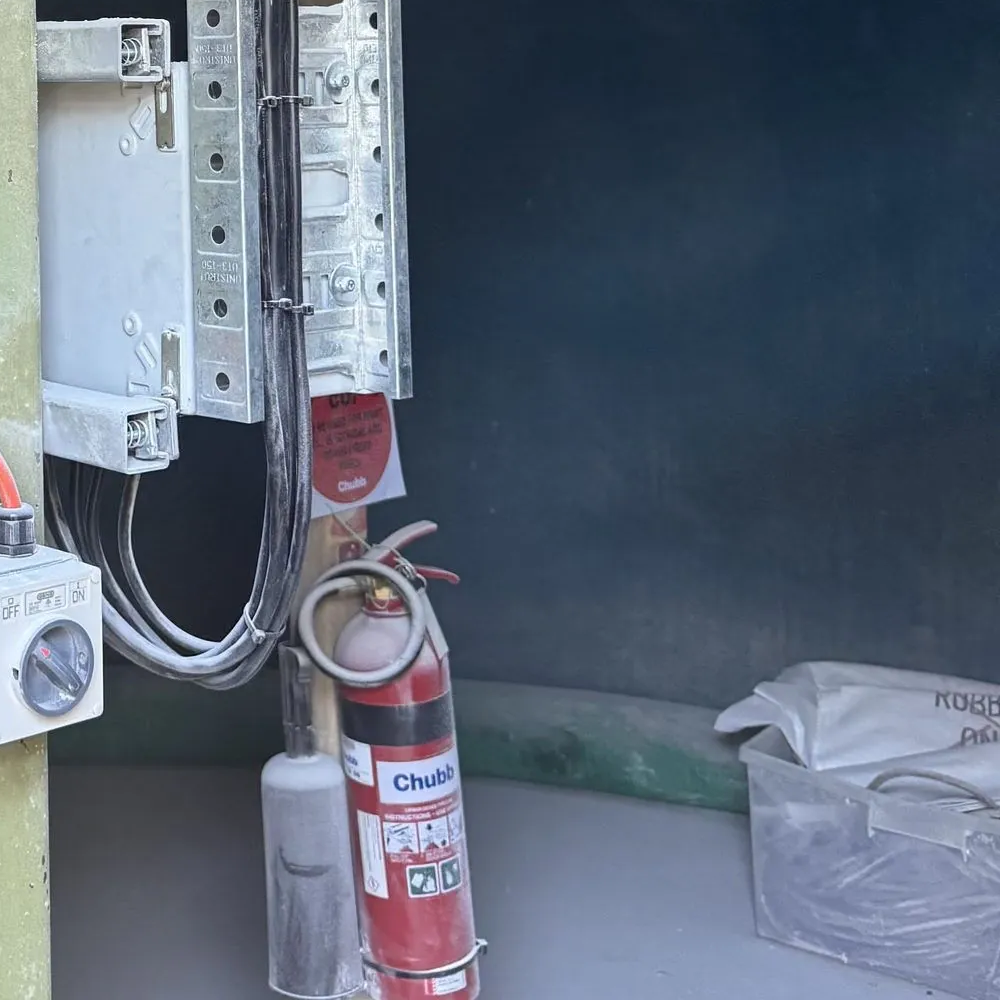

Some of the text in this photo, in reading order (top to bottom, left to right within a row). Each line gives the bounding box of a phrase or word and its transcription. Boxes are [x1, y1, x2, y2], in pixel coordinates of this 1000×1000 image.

[72, 588, 85, 603] ON
[3, 604, 20, 620] OFF
[393, 764, 454, 791] Chubb
